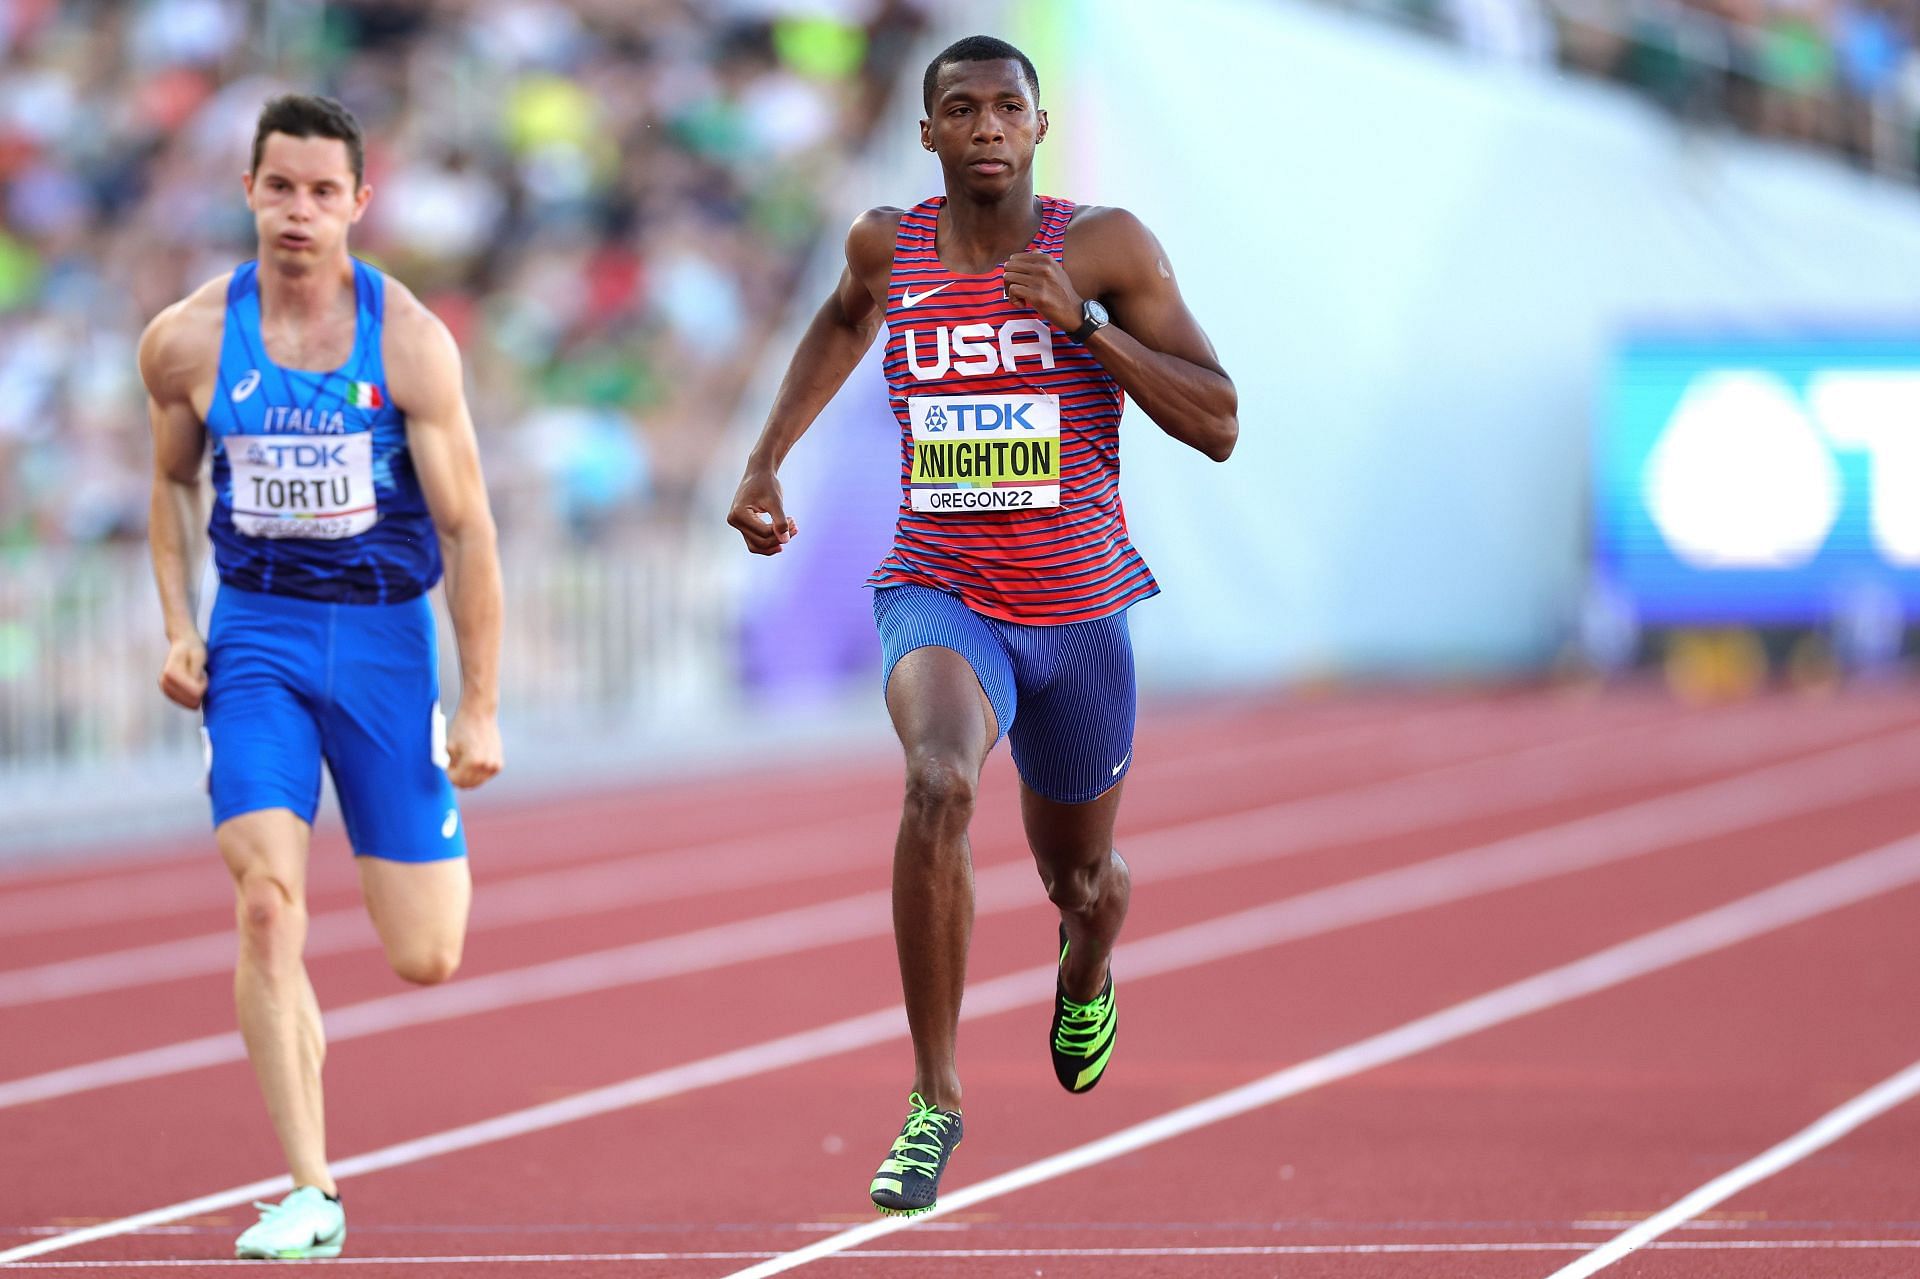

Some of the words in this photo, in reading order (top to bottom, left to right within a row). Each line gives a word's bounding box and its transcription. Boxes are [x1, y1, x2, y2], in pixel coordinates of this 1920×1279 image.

[905, 319, 1055, 381] USA
[264, 406, 345, 434] ITALIA
[946, 402, 1035, 431] TDK
[267, 444, 346, 469] TDK
[252, 476, 349, 508] TORTU
[930, 491, 1033, 508] OREGON22
